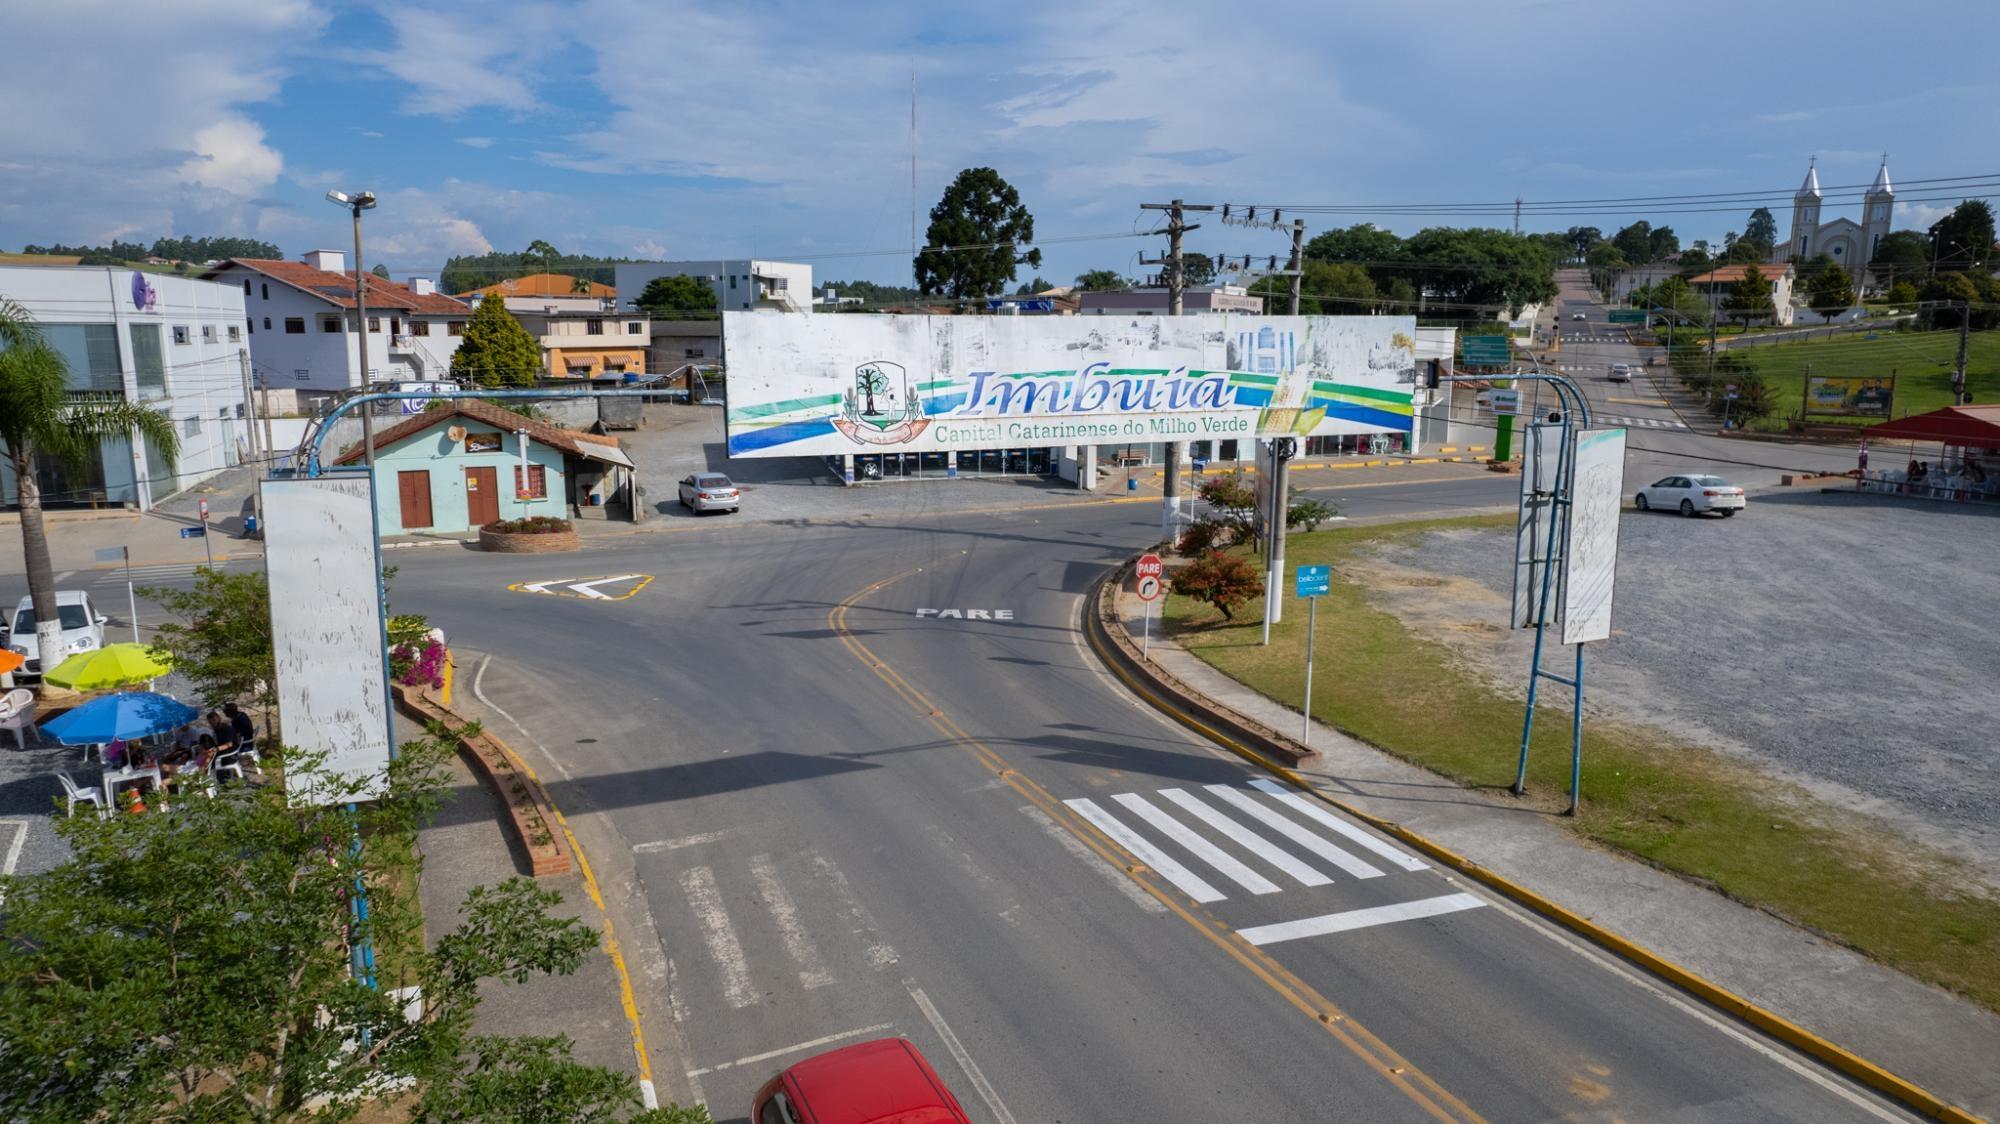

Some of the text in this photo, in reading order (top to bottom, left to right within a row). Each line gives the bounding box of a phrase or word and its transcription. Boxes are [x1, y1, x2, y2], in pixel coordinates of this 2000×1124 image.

[935, 416, 1248, 443] Capital Catarinense do Milho Verde
[1138, 563, 1160, 574] PARE
[915, 607, 1014, 620] PARE
